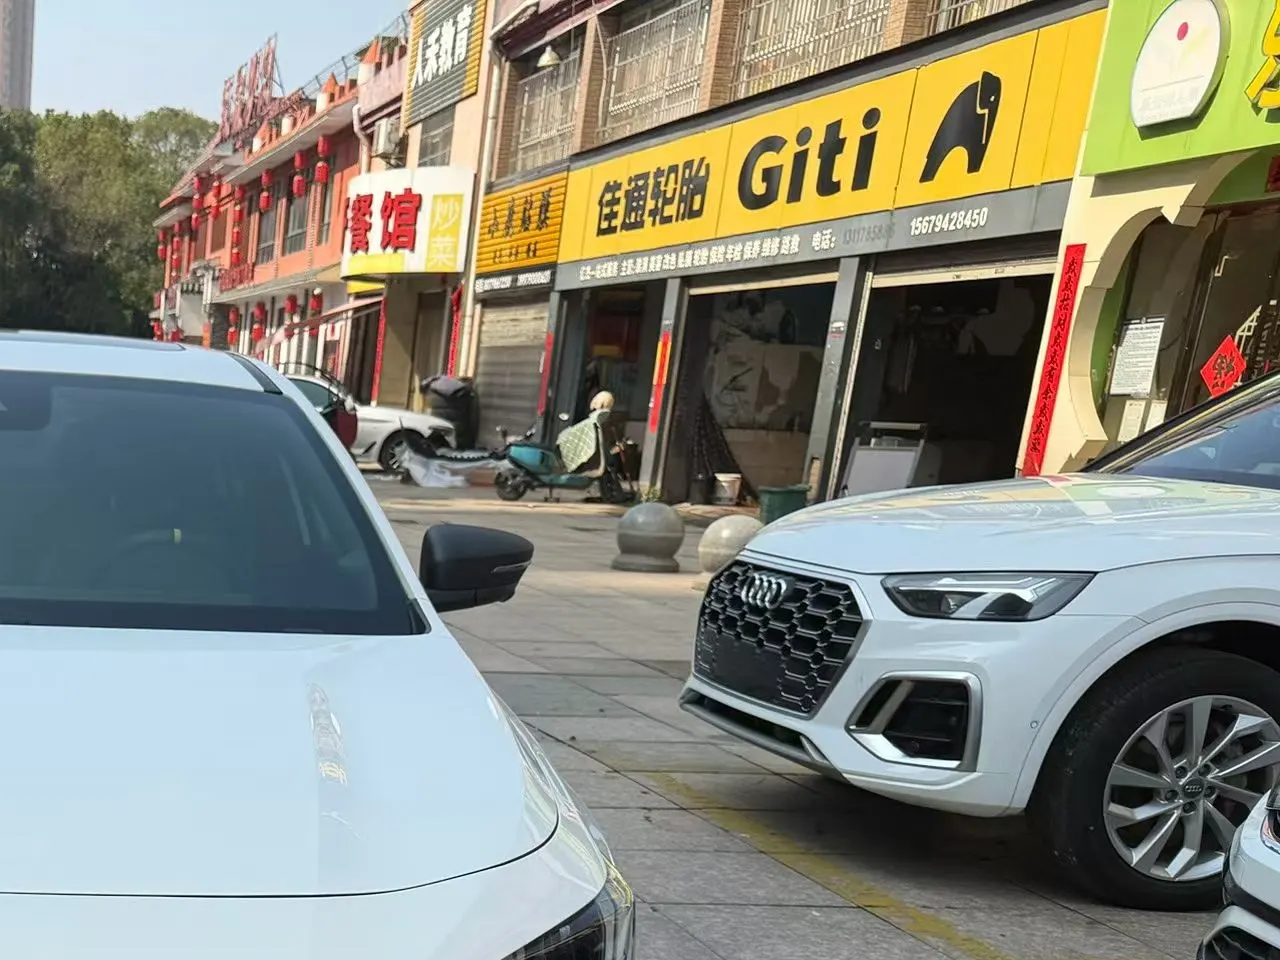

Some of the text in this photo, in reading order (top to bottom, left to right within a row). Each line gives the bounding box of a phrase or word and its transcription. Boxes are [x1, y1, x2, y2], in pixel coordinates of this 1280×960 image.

[738, 107, 881, 211] Giti
[342, 187, 423, 255] 餐馆
[596, 156, 710, 237] 佳通轮胎
[910, 207, 988, 236] 15679428450
[429, 197, 460, 268] 炒菜
